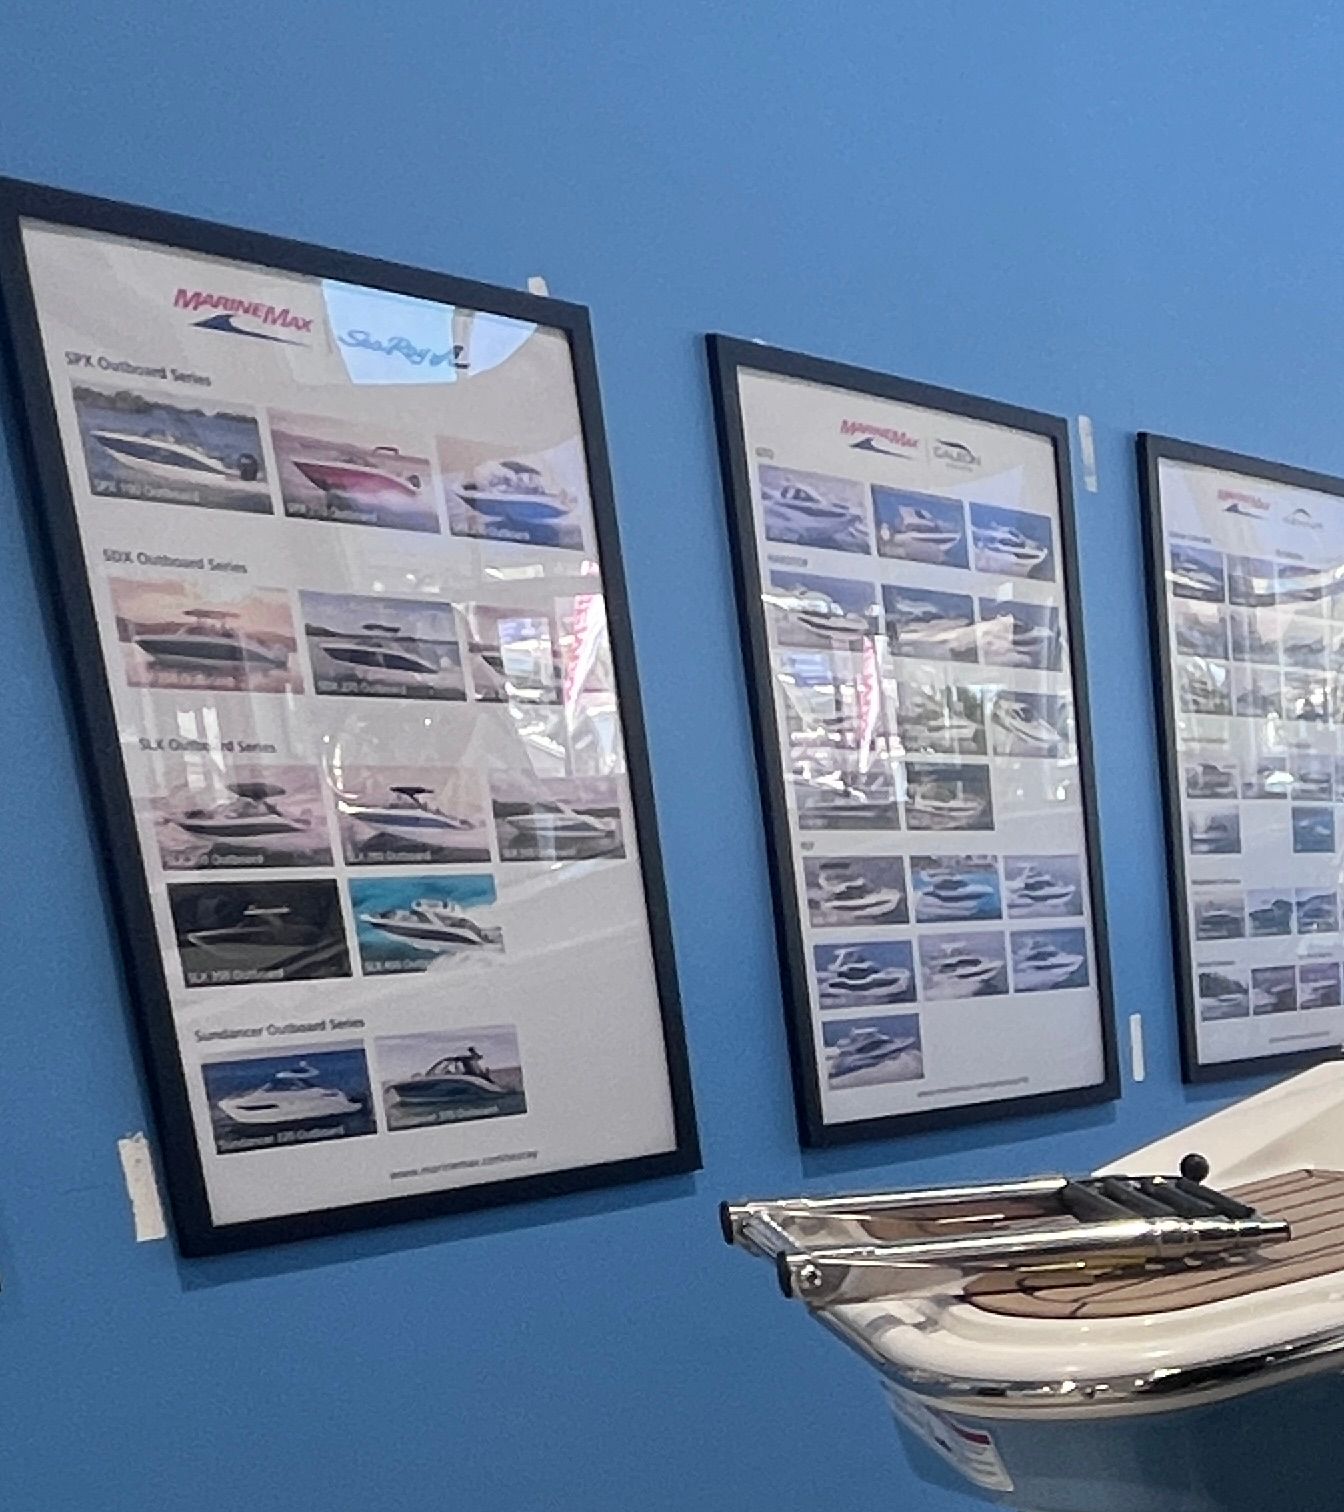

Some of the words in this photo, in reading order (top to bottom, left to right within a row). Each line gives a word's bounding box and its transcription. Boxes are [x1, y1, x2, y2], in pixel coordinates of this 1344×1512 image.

[174, 288, 312, 332] MARINEMAX
[97, 356, 168, 380] Outboard
[136, 552, 204, 570] Outboard
[266, 1020, 326, 1036] Outboard
